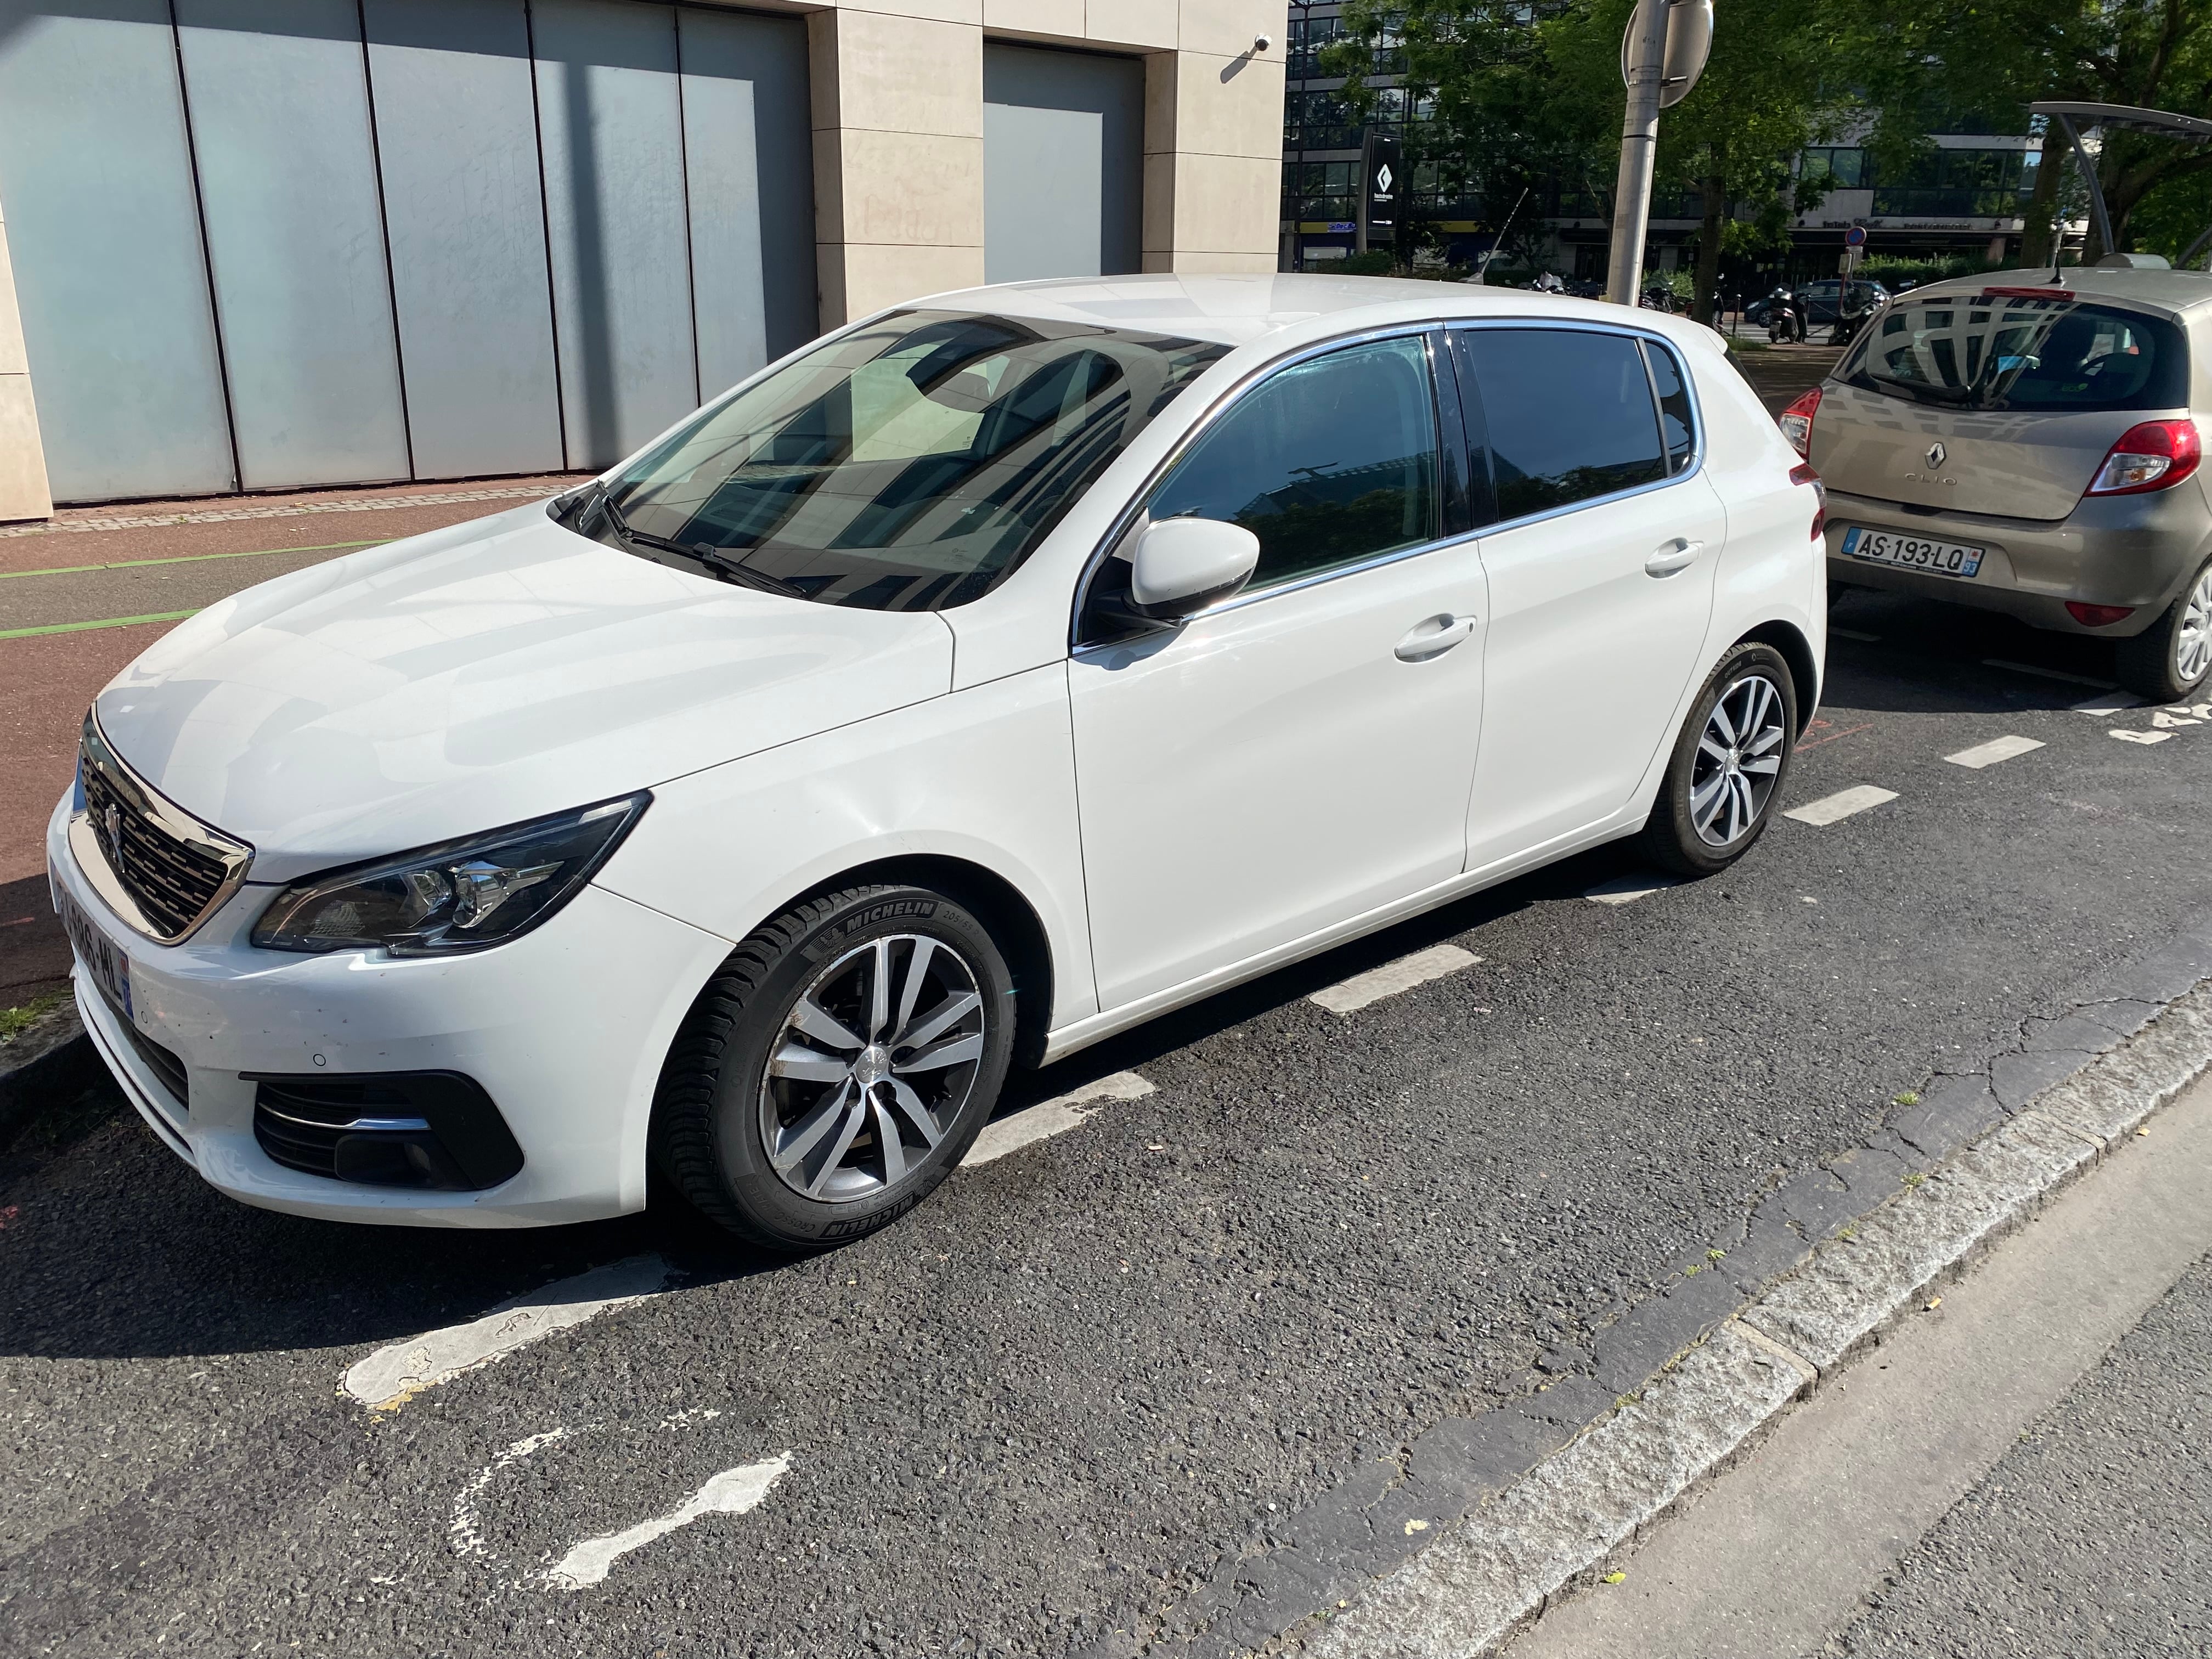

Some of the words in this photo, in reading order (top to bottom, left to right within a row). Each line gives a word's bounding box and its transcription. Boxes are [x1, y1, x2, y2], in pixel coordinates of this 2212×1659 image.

[1905, 473, 1957, 486] CLIO
[1858, 534, 1964, 571] AS-193-LQ
[1963, 562, 1978, 573] 93
[847, 902, 934, 934] MICHELIN
[943, 911, 973, 931] 205/55
[826, 1194, 913, 1236] MICHELIN
